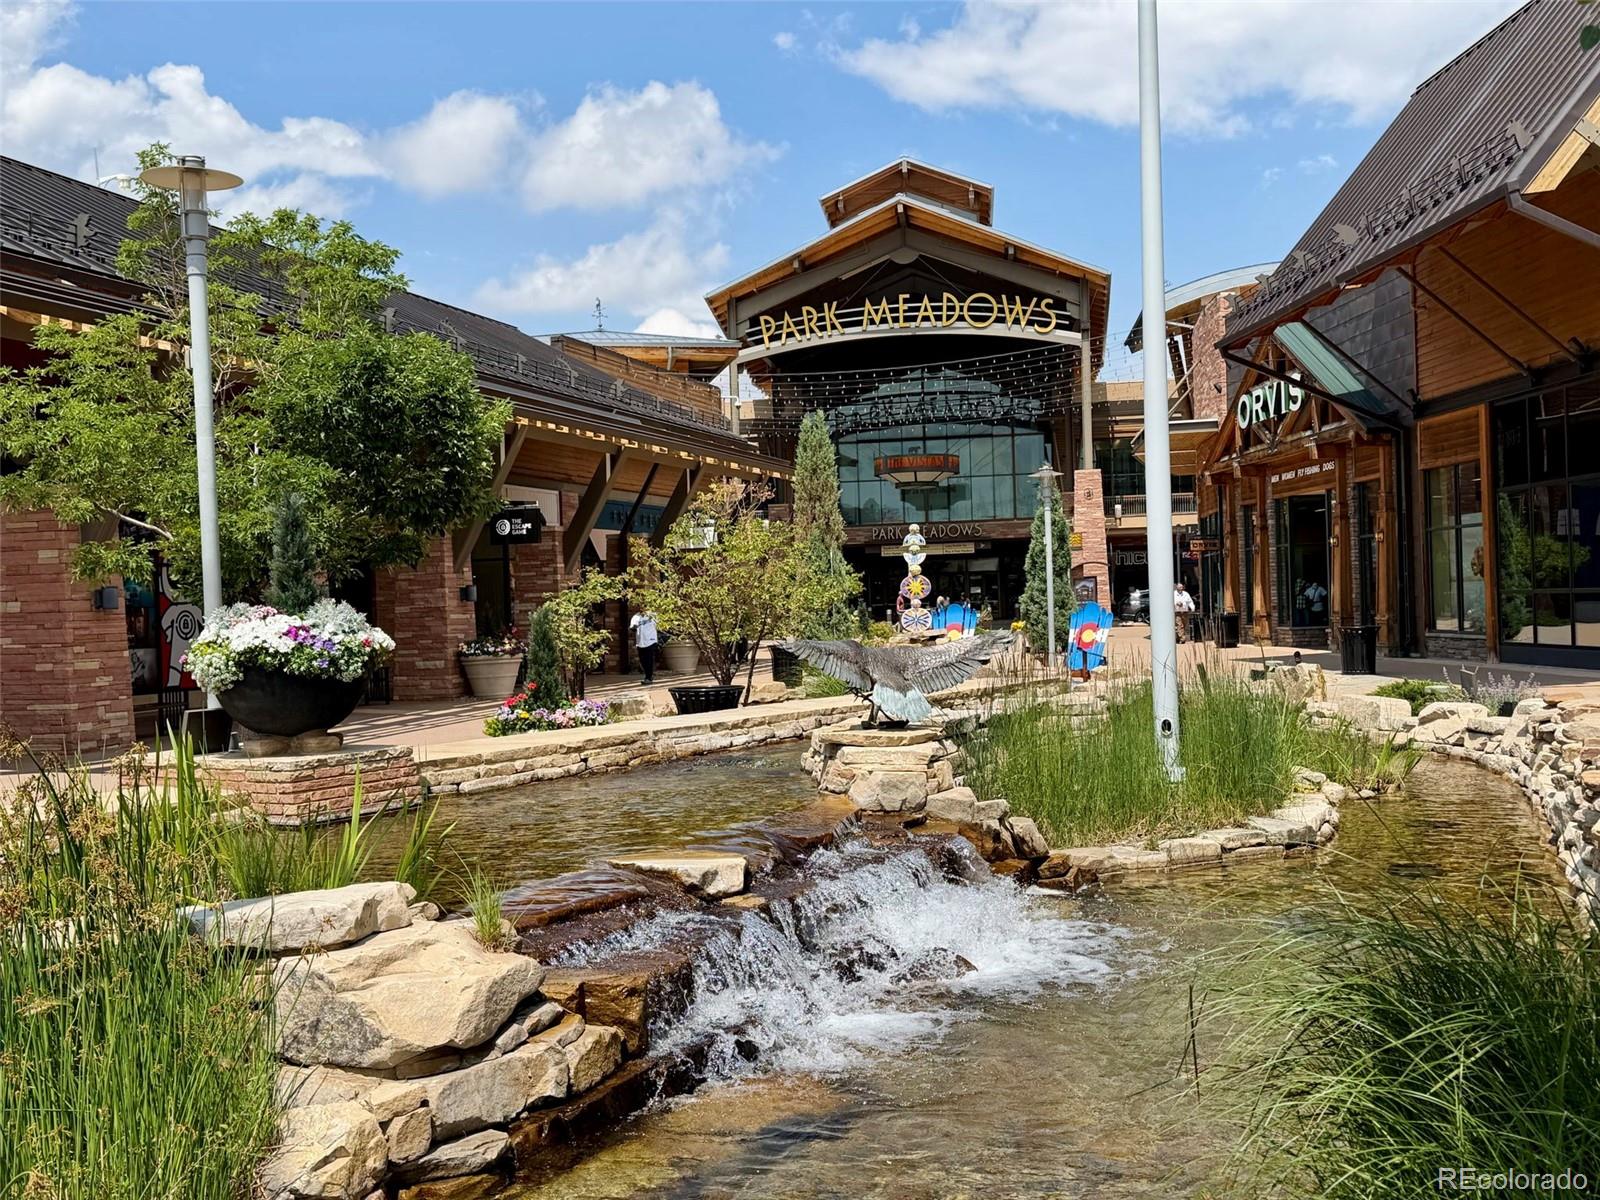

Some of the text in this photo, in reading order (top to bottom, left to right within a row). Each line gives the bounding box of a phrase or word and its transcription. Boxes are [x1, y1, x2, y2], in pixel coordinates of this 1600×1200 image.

[760, 292, 1057, 350] PARK MEADOWS
[1238, 373, 1303, 429] ORVIS
[1271, 461, 1335, 483] MEN WOMEN FLY FISHING DOGS
[872, 523, 983, 540] PARK EADOWS
[1115, 549, 1148, 566] hic
